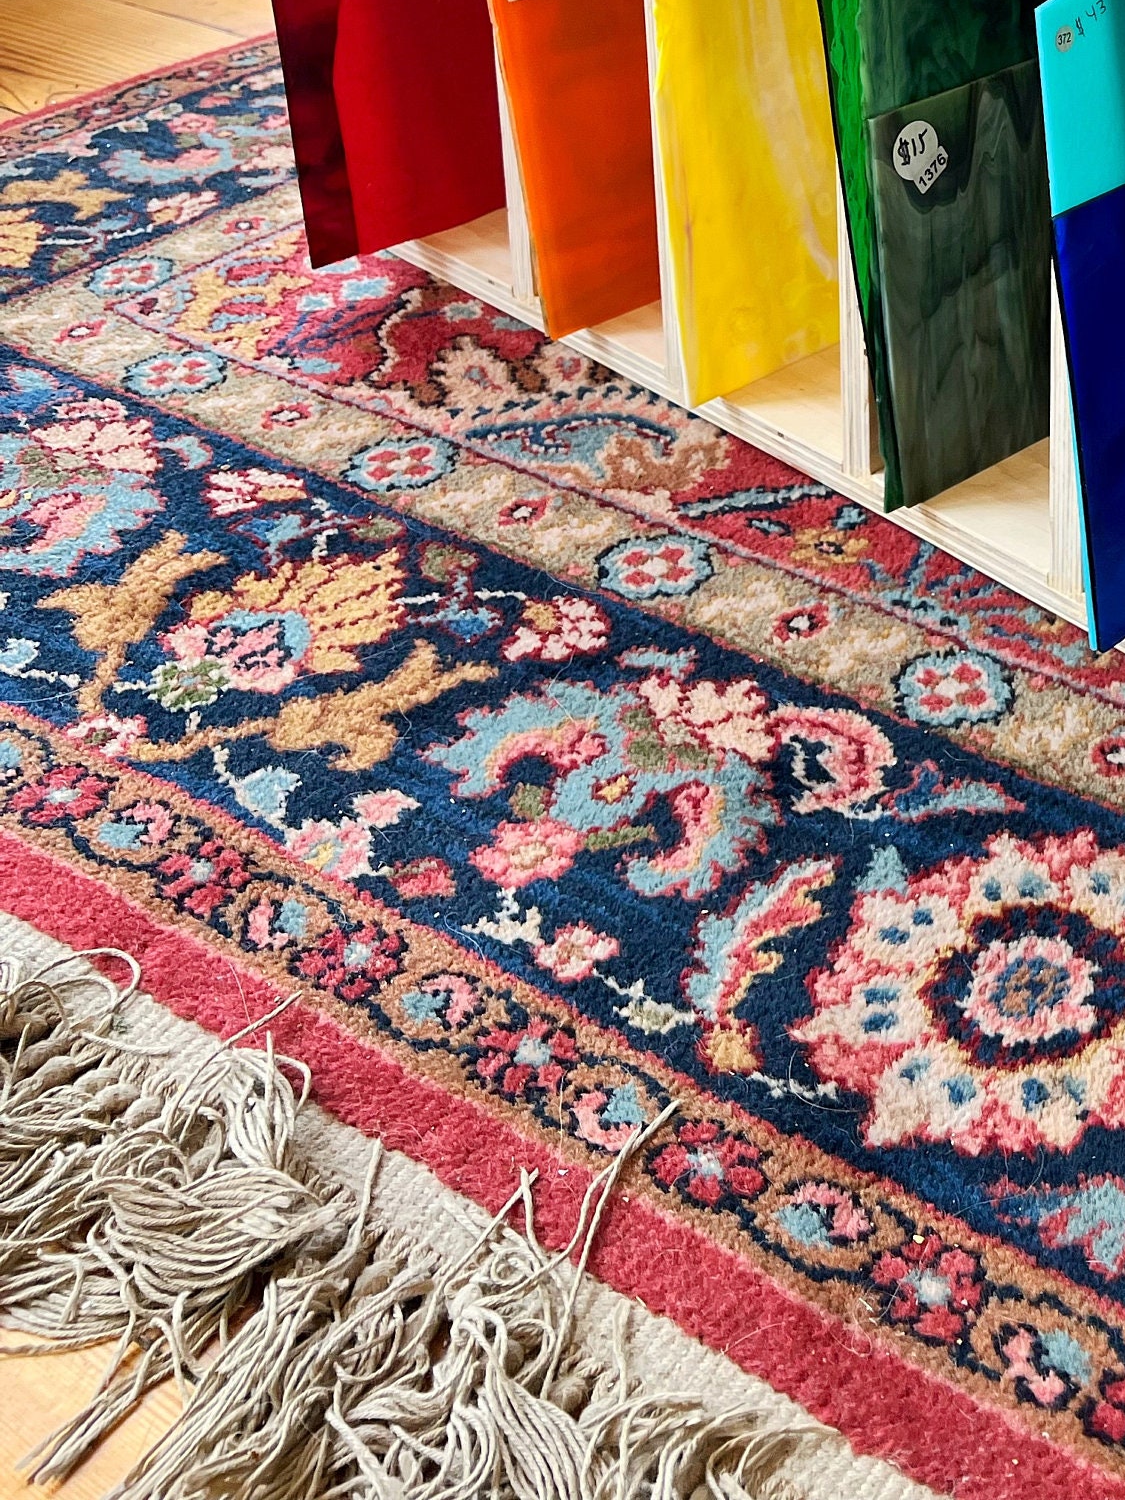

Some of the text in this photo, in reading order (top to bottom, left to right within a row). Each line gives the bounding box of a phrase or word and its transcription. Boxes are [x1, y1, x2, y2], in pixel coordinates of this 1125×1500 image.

[1057, 31, 1072, 46] 372
[897, 128, 928, 166] $15
[919, 153, 947, 187] 1376
